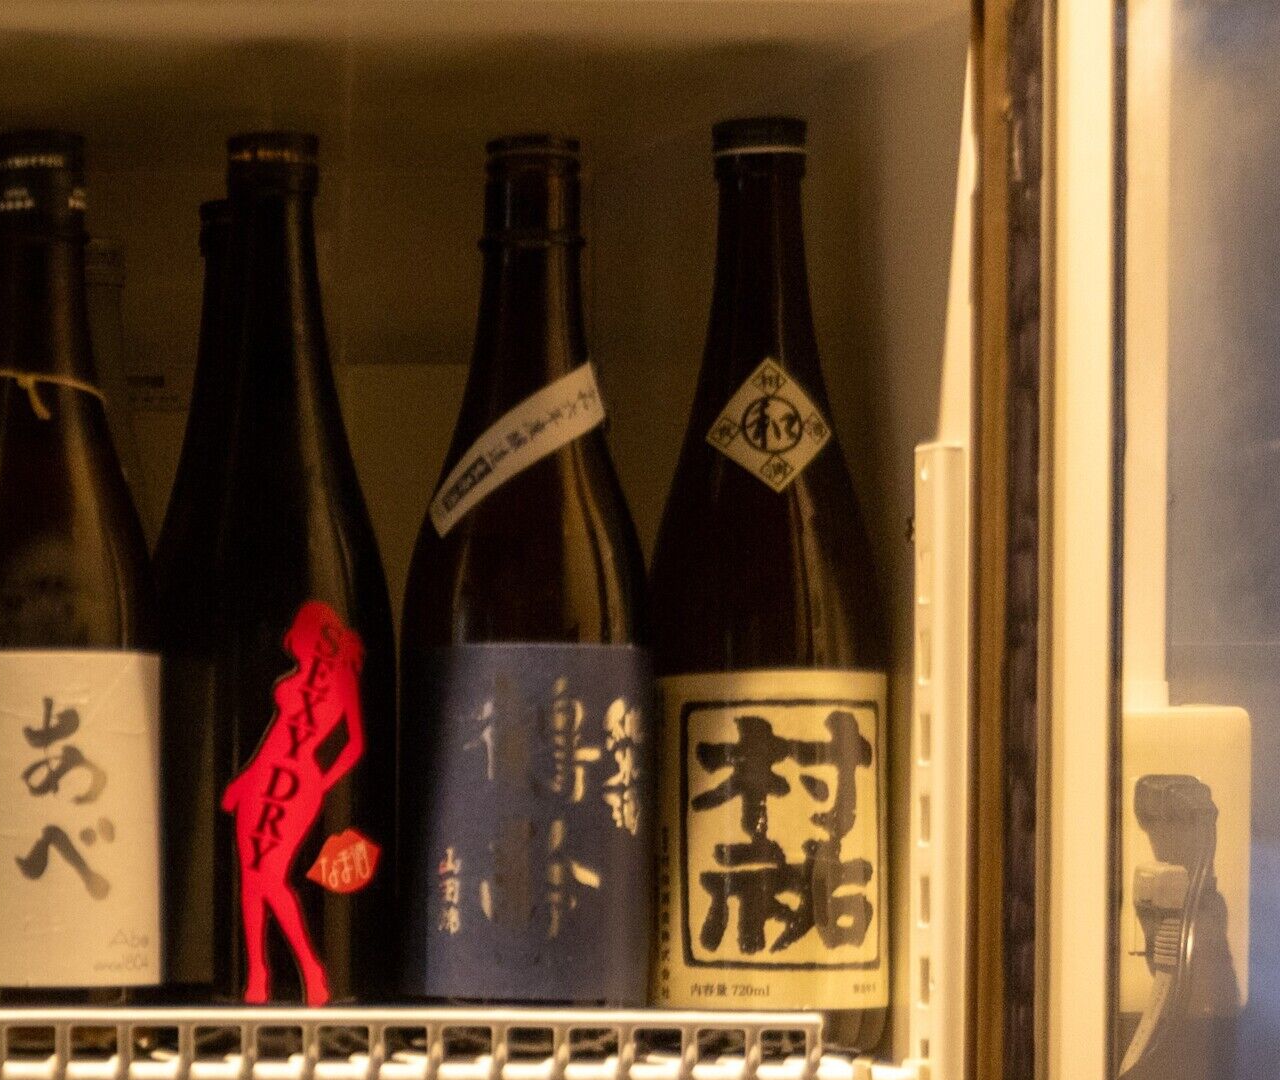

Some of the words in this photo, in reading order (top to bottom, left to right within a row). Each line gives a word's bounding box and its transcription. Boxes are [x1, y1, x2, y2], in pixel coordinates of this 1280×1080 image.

[16, 697, 116, 900] あべ
[247, 768, 299, 871] DRY
[692, 710, 874, 955] 村祐
[690, 984, 727, 997] 内容量
[732, 984, 770, 996] 720ml
